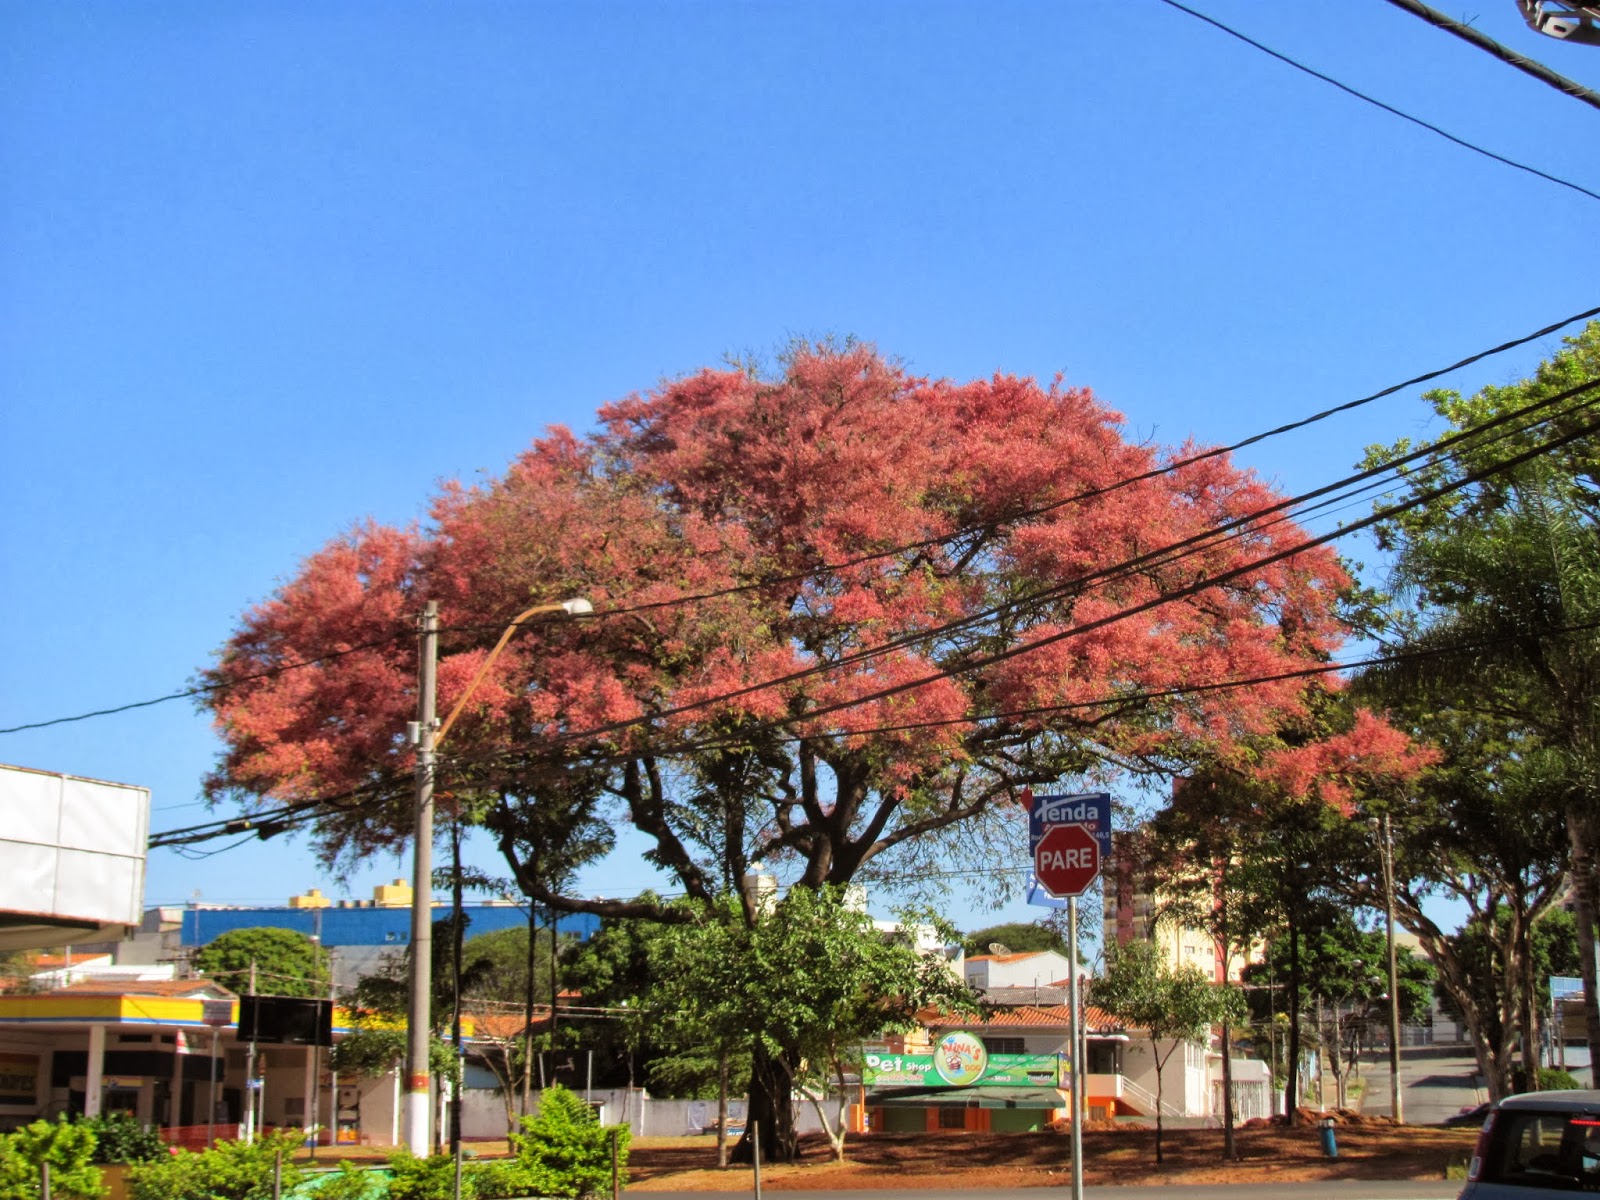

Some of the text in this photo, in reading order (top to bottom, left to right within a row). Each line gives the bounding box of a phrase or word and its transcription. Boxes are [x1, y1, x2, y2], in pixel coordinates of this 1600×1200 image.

[1034, 794, 1100, 822] Tenda
[1040, 847, 1093, 872] PARE
[866, 1055, 932, 1072] Pet Shop
